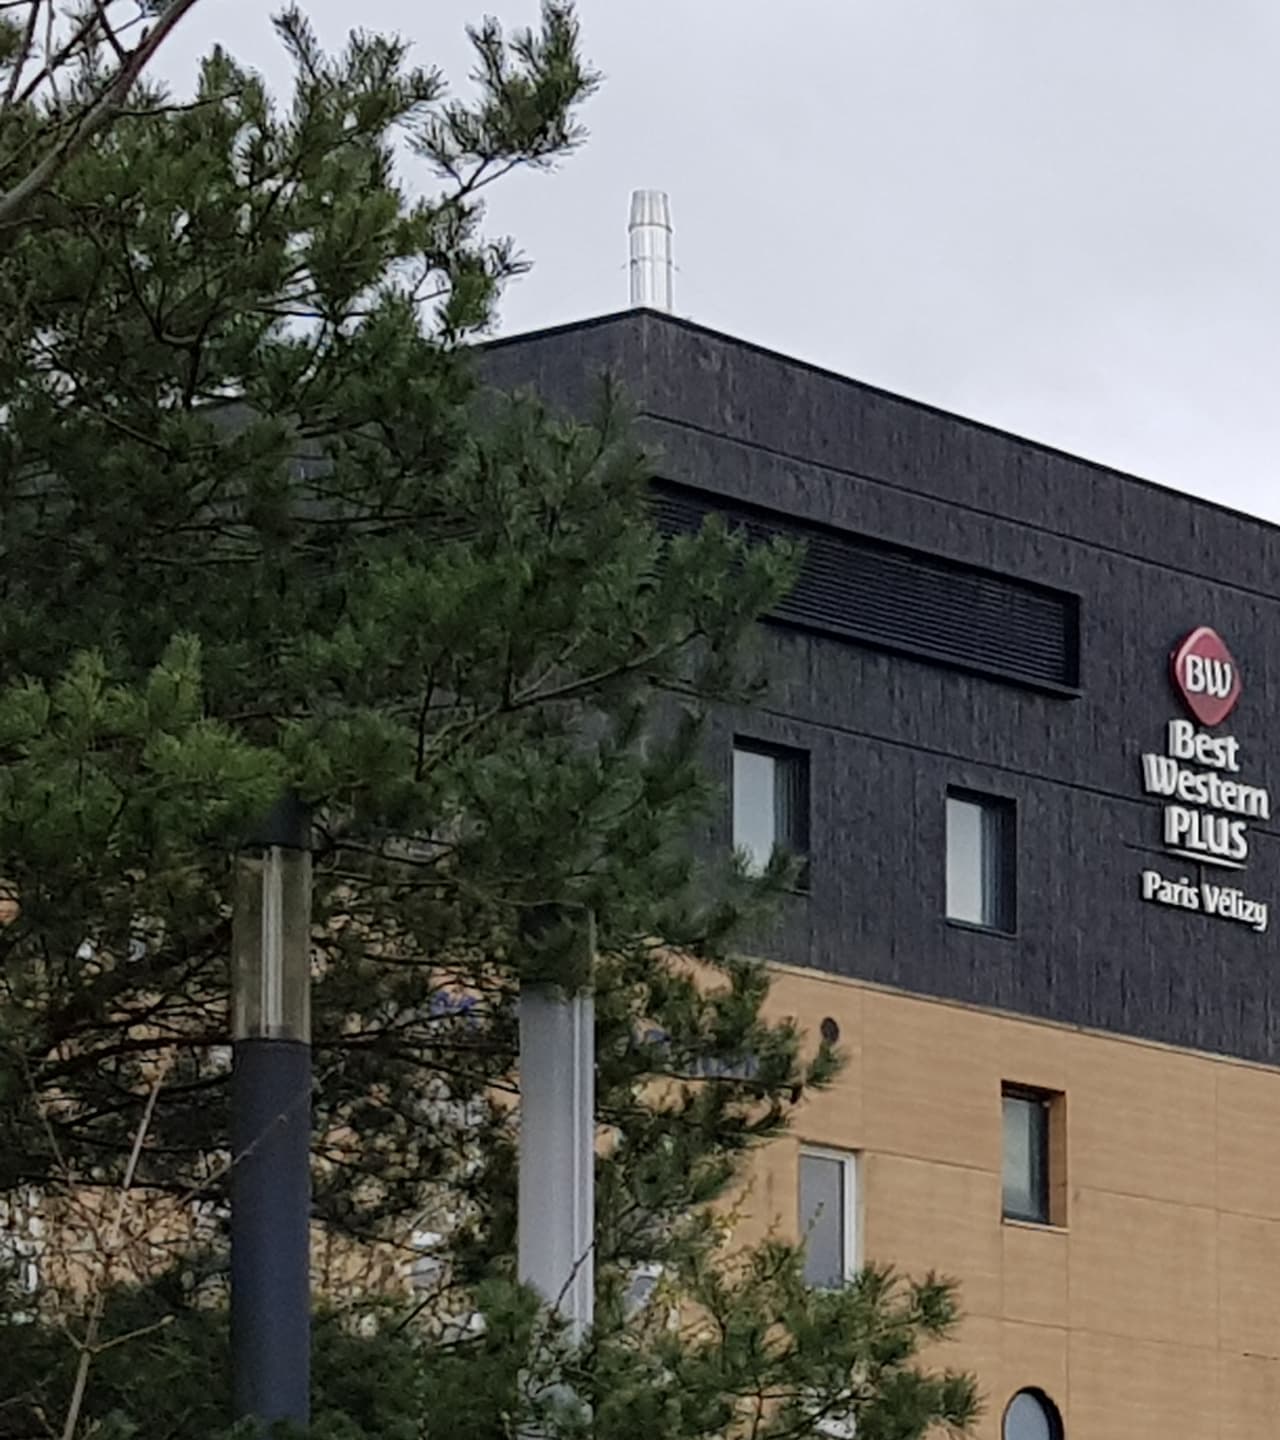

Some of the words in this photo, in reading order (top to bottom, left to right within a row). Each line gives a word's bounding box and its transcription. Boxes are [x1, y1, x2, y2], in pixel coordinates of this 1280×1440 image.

[1185, 654, 1232, 698] BW
[1169, 719, 1240, 772] Best
[1142, 753, 1270, 819] Western
[1164, 805, 1248, 860] PLUS
[1142, 870, 1200, 910] Paris
[1201, 884, 1268, 931] Vélizy
